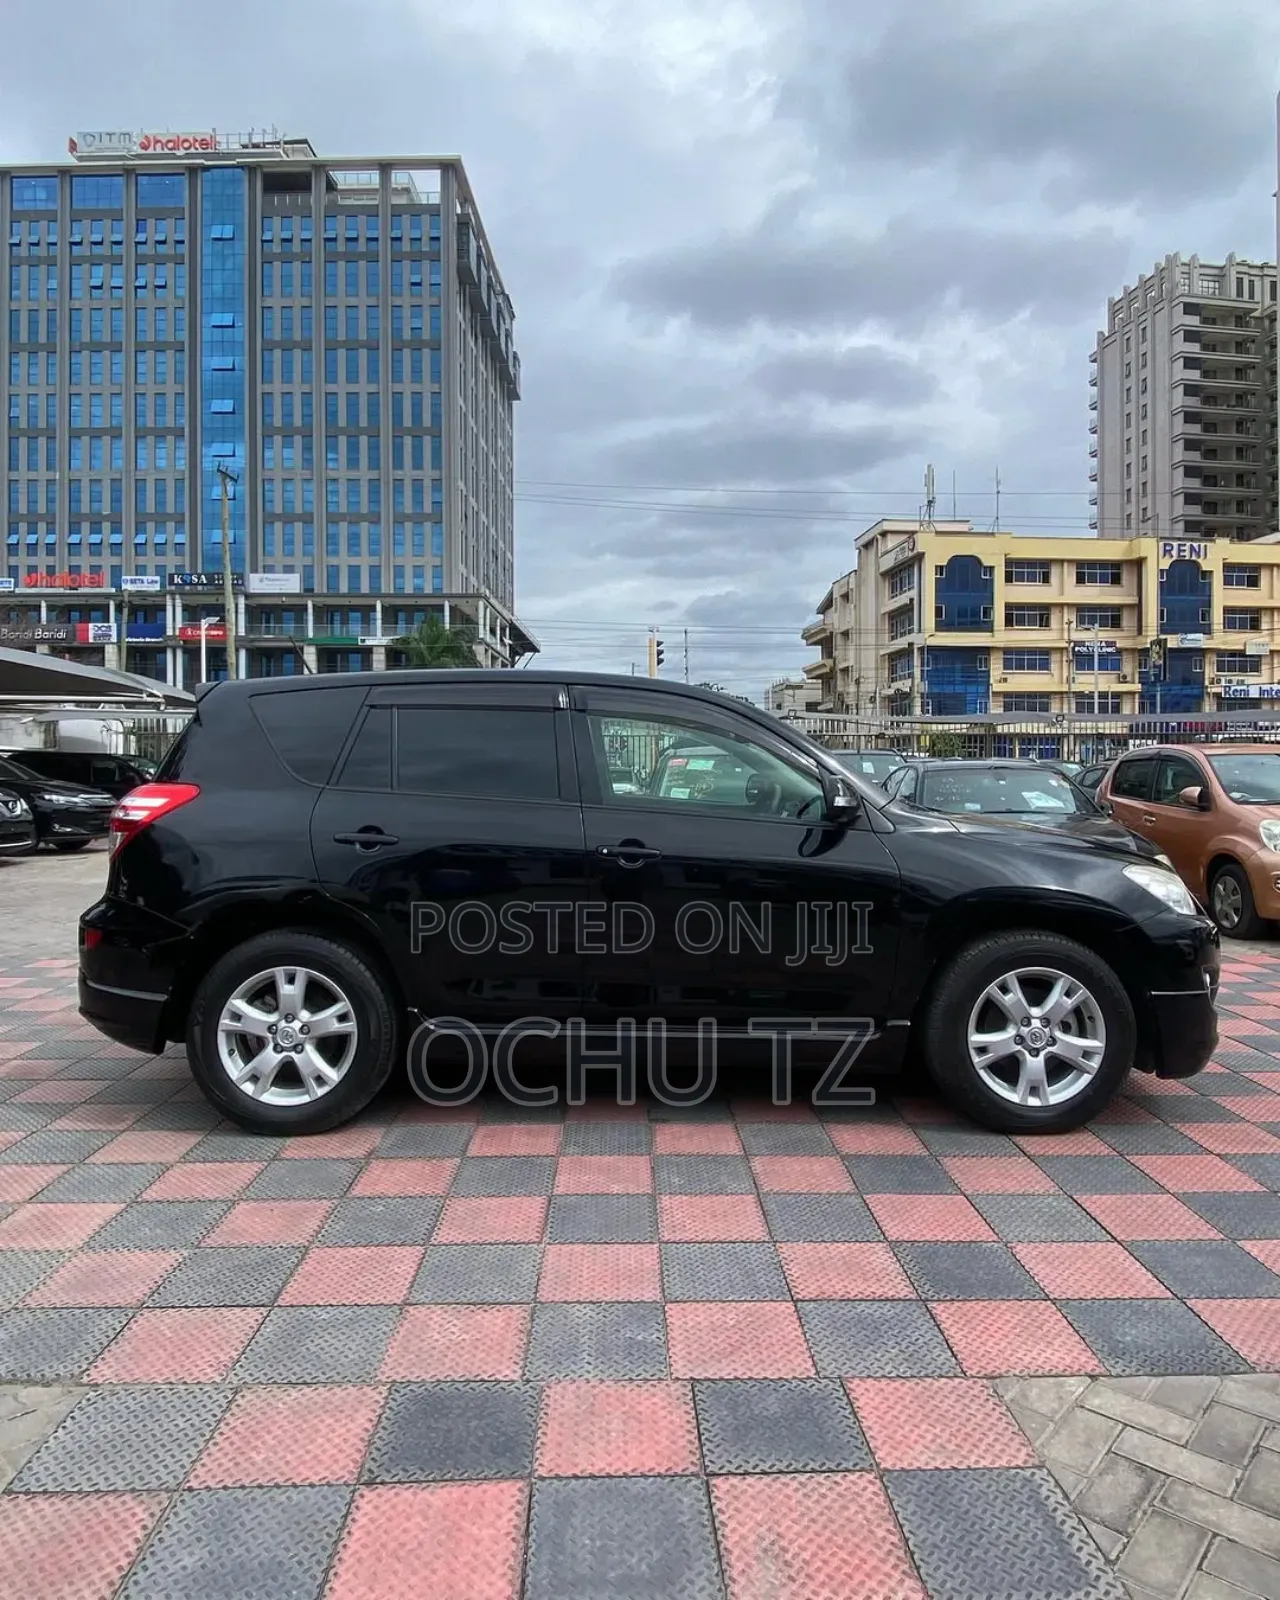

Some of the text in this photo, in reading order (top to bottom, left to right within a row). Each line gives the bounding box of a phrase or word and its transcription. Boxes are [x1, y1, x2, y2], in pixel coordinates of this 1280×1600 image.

[153, 134, 215, 151] halotel
[1162, 542, 1208, 560] RENI
[40, 570, 105, 588] halotel
[34, 628, 67, 639] Baridi
[1223, 685, 1250, 697] Reni
